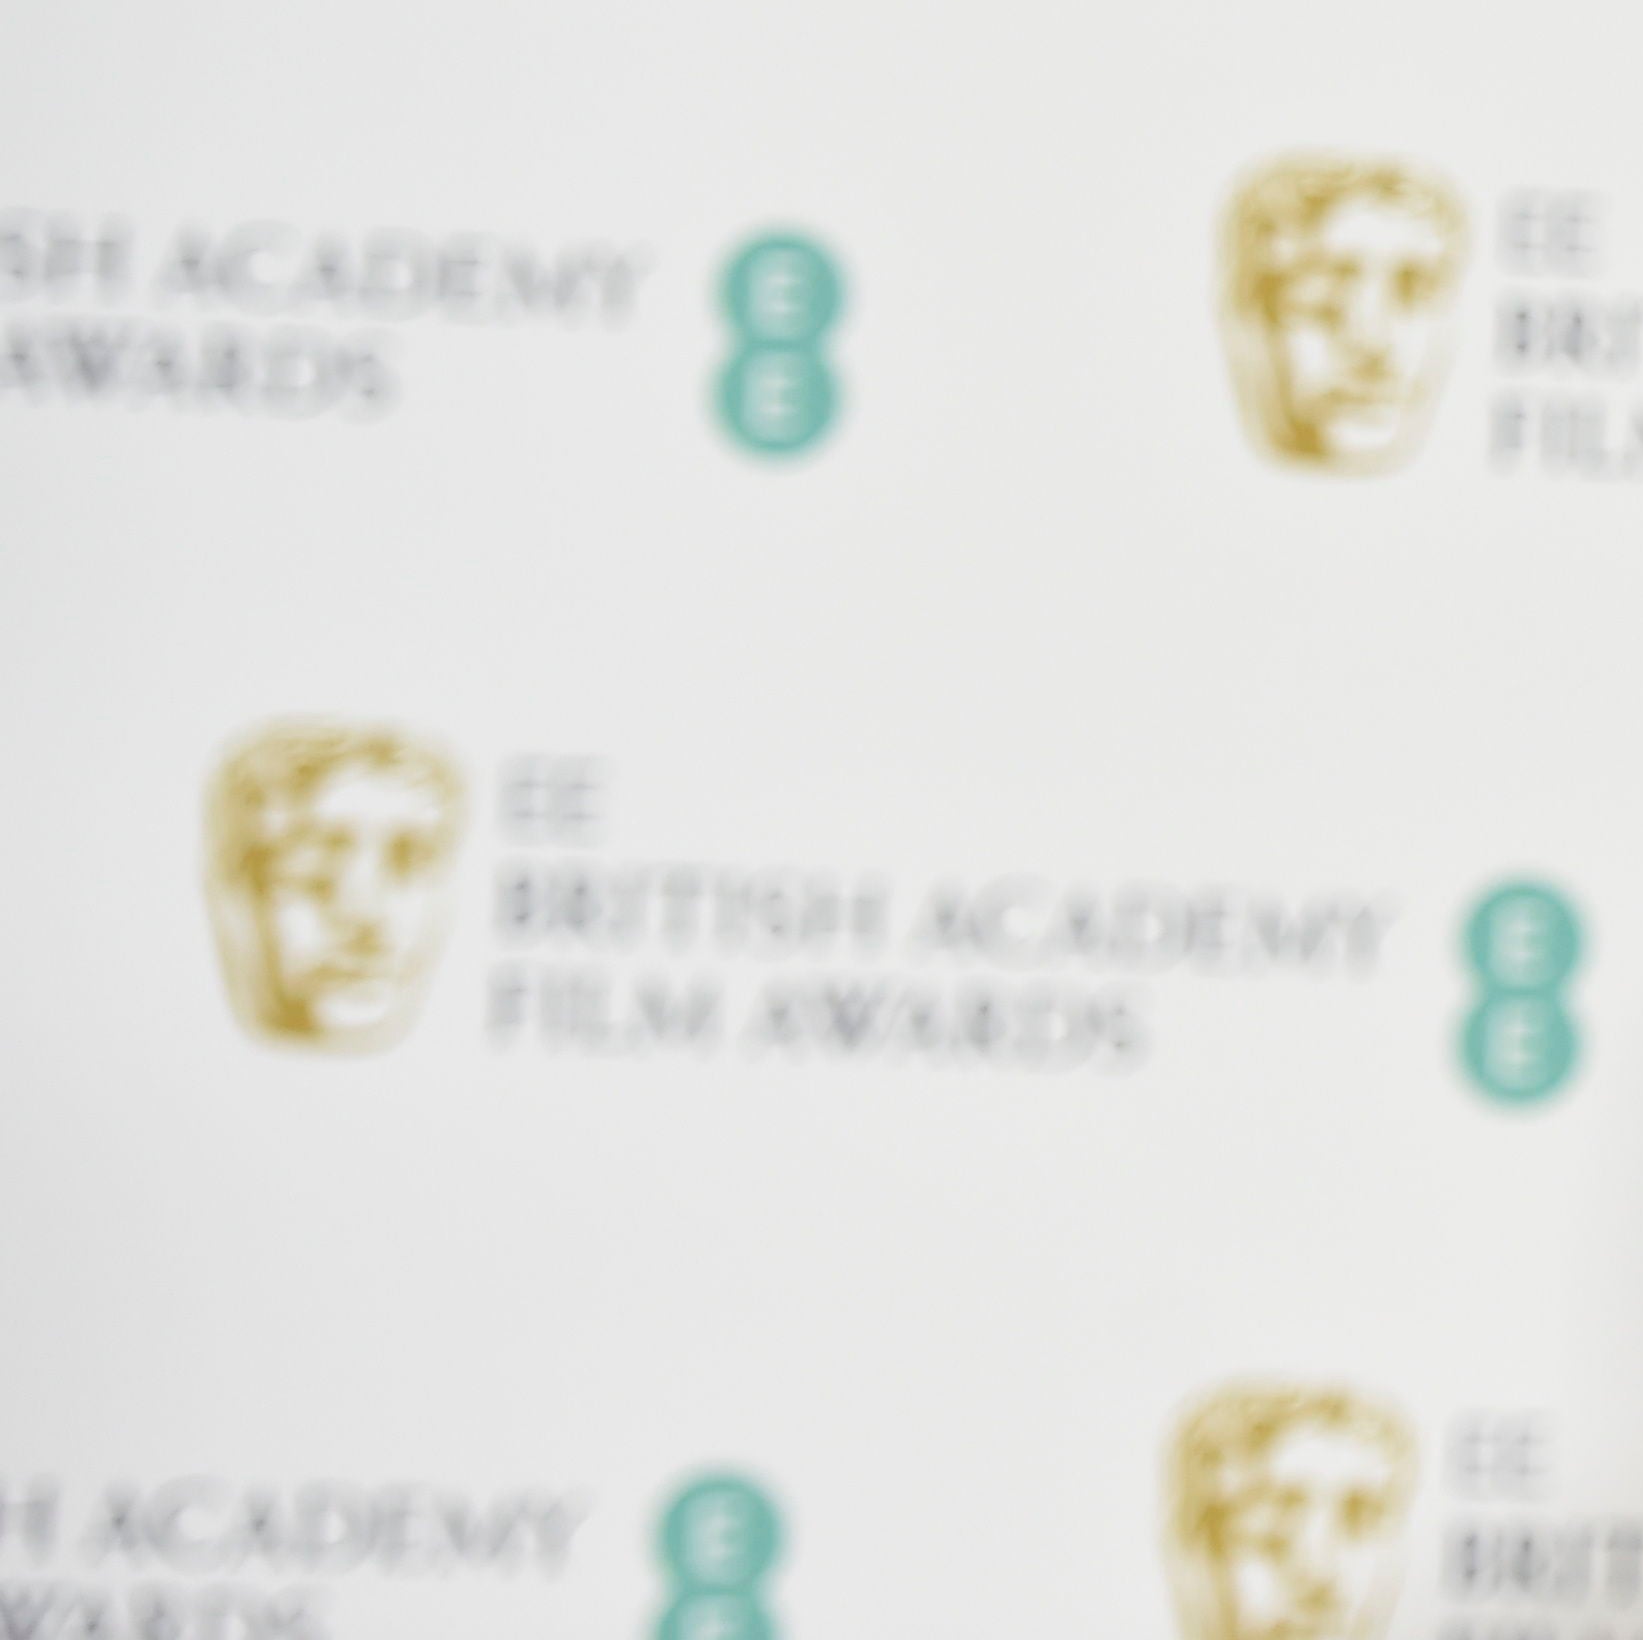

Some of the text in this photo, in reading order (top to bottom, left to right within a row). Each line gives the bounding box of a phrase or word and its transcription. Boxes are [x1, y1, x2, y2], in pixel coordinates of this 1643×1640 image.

[157, 223, 650, 329] ACADEMY
[495, 860, 1400, 980] BRITISH ACADEMY
[486, 963, 1152, 1076] FILM AWARDS
[82, 1473, 586, 1580] ACADEMY
